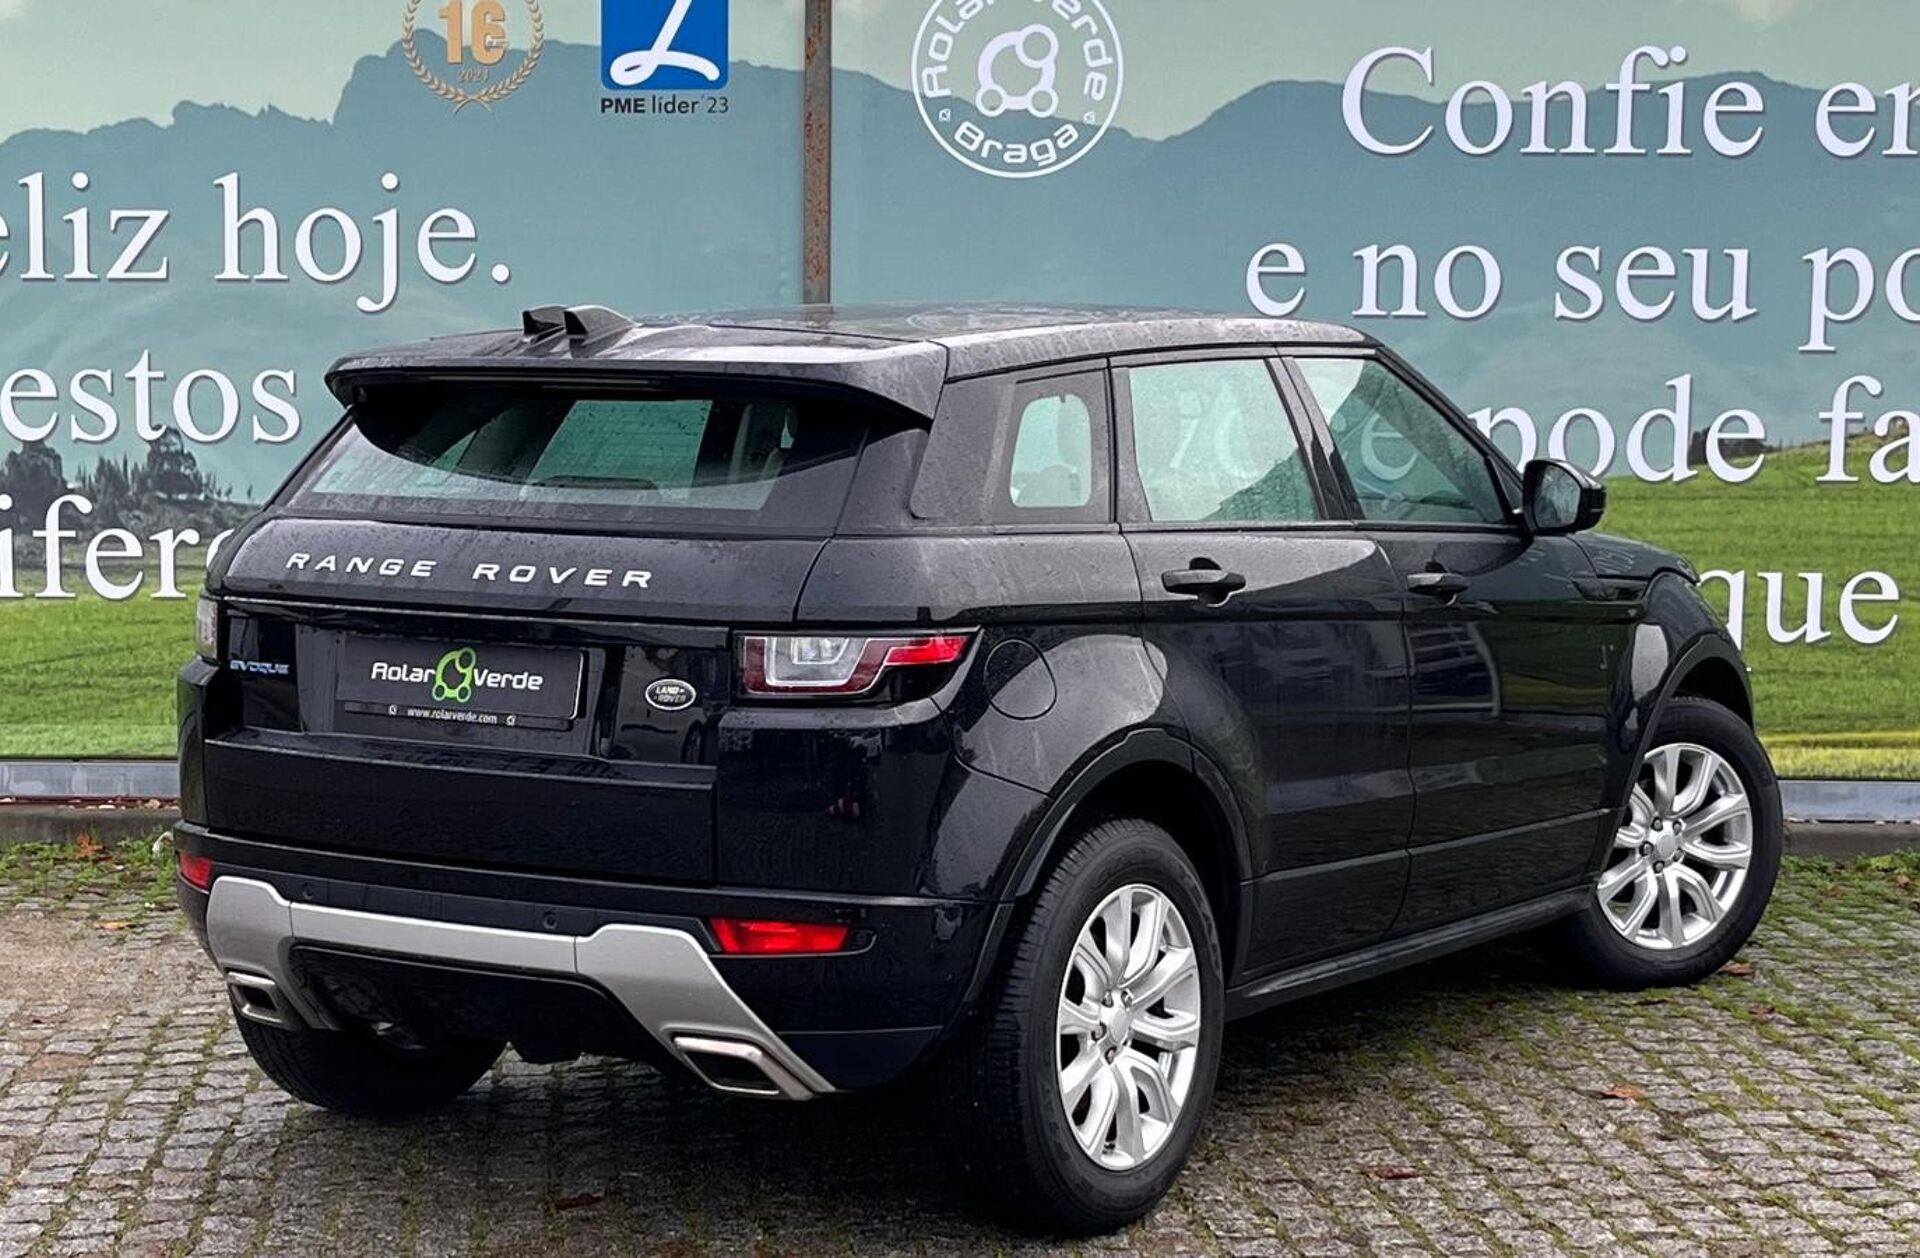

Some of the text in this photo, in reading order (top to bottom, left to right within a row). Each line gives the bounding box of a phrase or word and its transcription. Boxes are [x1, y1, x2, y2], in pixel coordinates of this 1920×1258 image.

[922, 0, 993, 98] Rola
[601, 97, 646, 114] PME
[652, 94, 698, 114] líder
[1342, 46, 1764, 156] Confie
[954, 121, 1079, 167] Braga
[0, 172, 510, 312] liz hoje.
[1245, 242, 1306, 316] e
[1352, 243, 1502, 318] no
[1554, 244, 1758, 320] seu
[0, 494, 235, 599] ifer
[287, 552, 653, 589] RANGE ROVER
[371, 662, 543, 690] Rolar Verde
[407, 708, 498, 725] www.rolarverde.com
